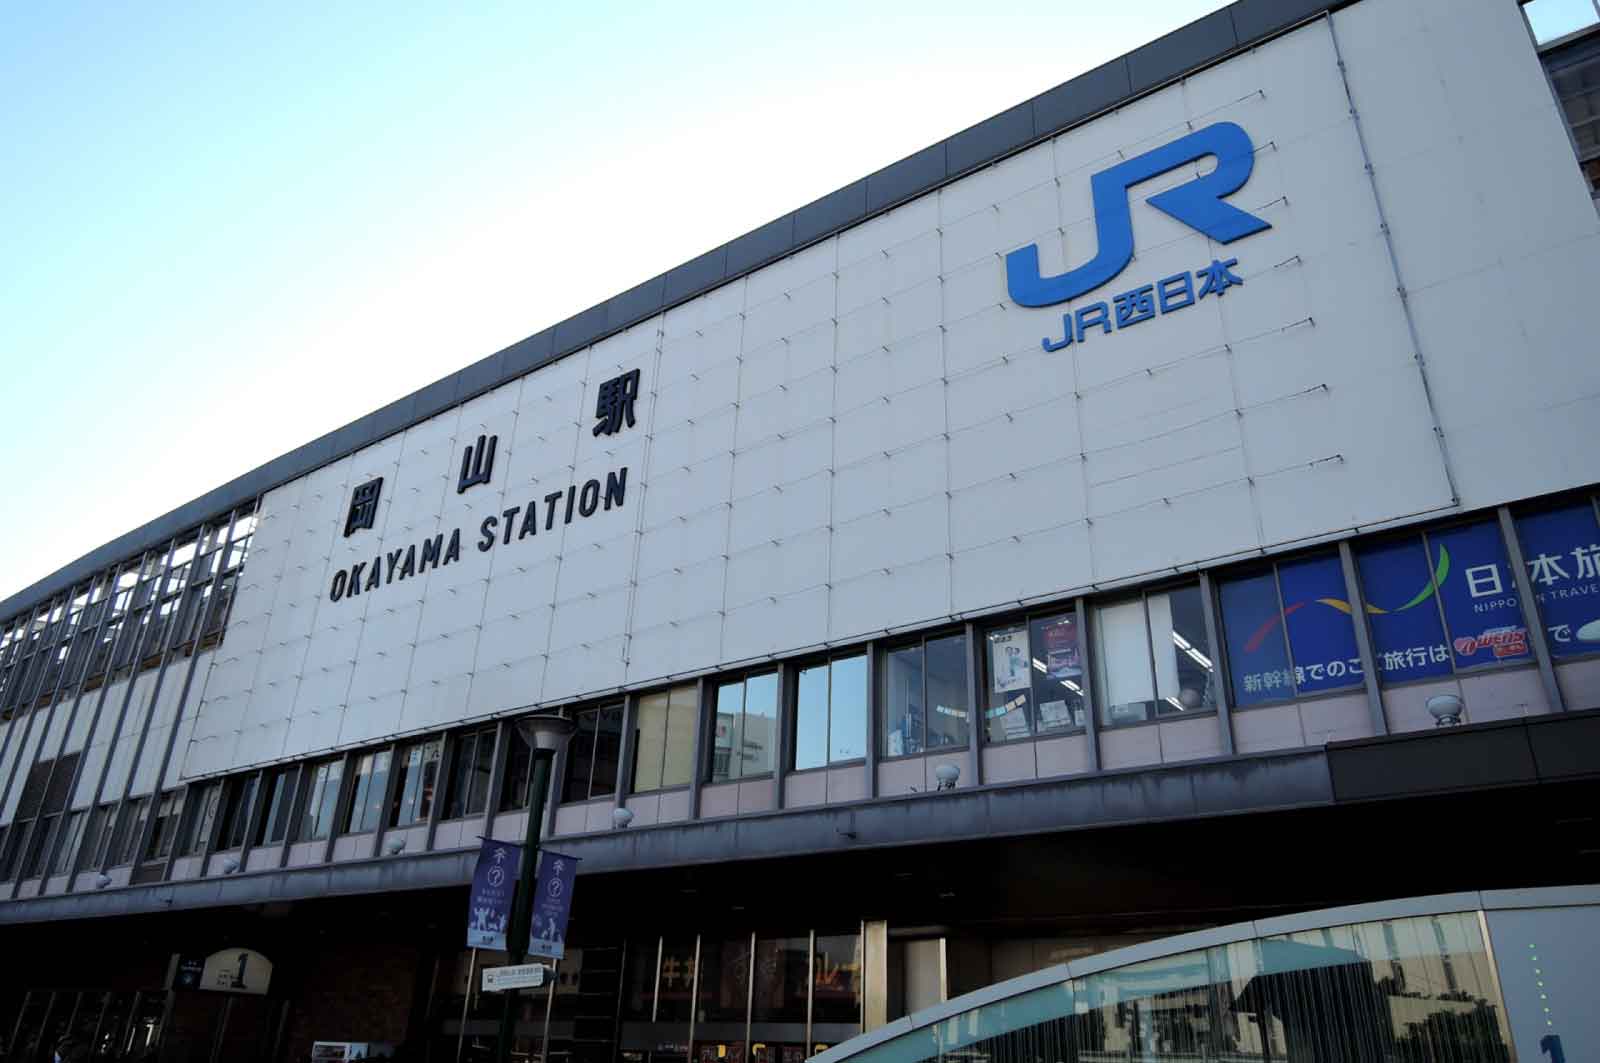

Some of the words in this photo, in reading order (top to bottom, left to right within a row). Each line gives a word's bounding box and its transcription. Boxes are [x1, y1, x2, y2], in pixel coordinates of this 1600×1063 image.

[1006, 121, 1272, 308] JR
[1041, 258, 1243, 352] JR西日本
[329, 528, 460, 602] OKAYAMA
[477, 466, 628, 552] STATION
